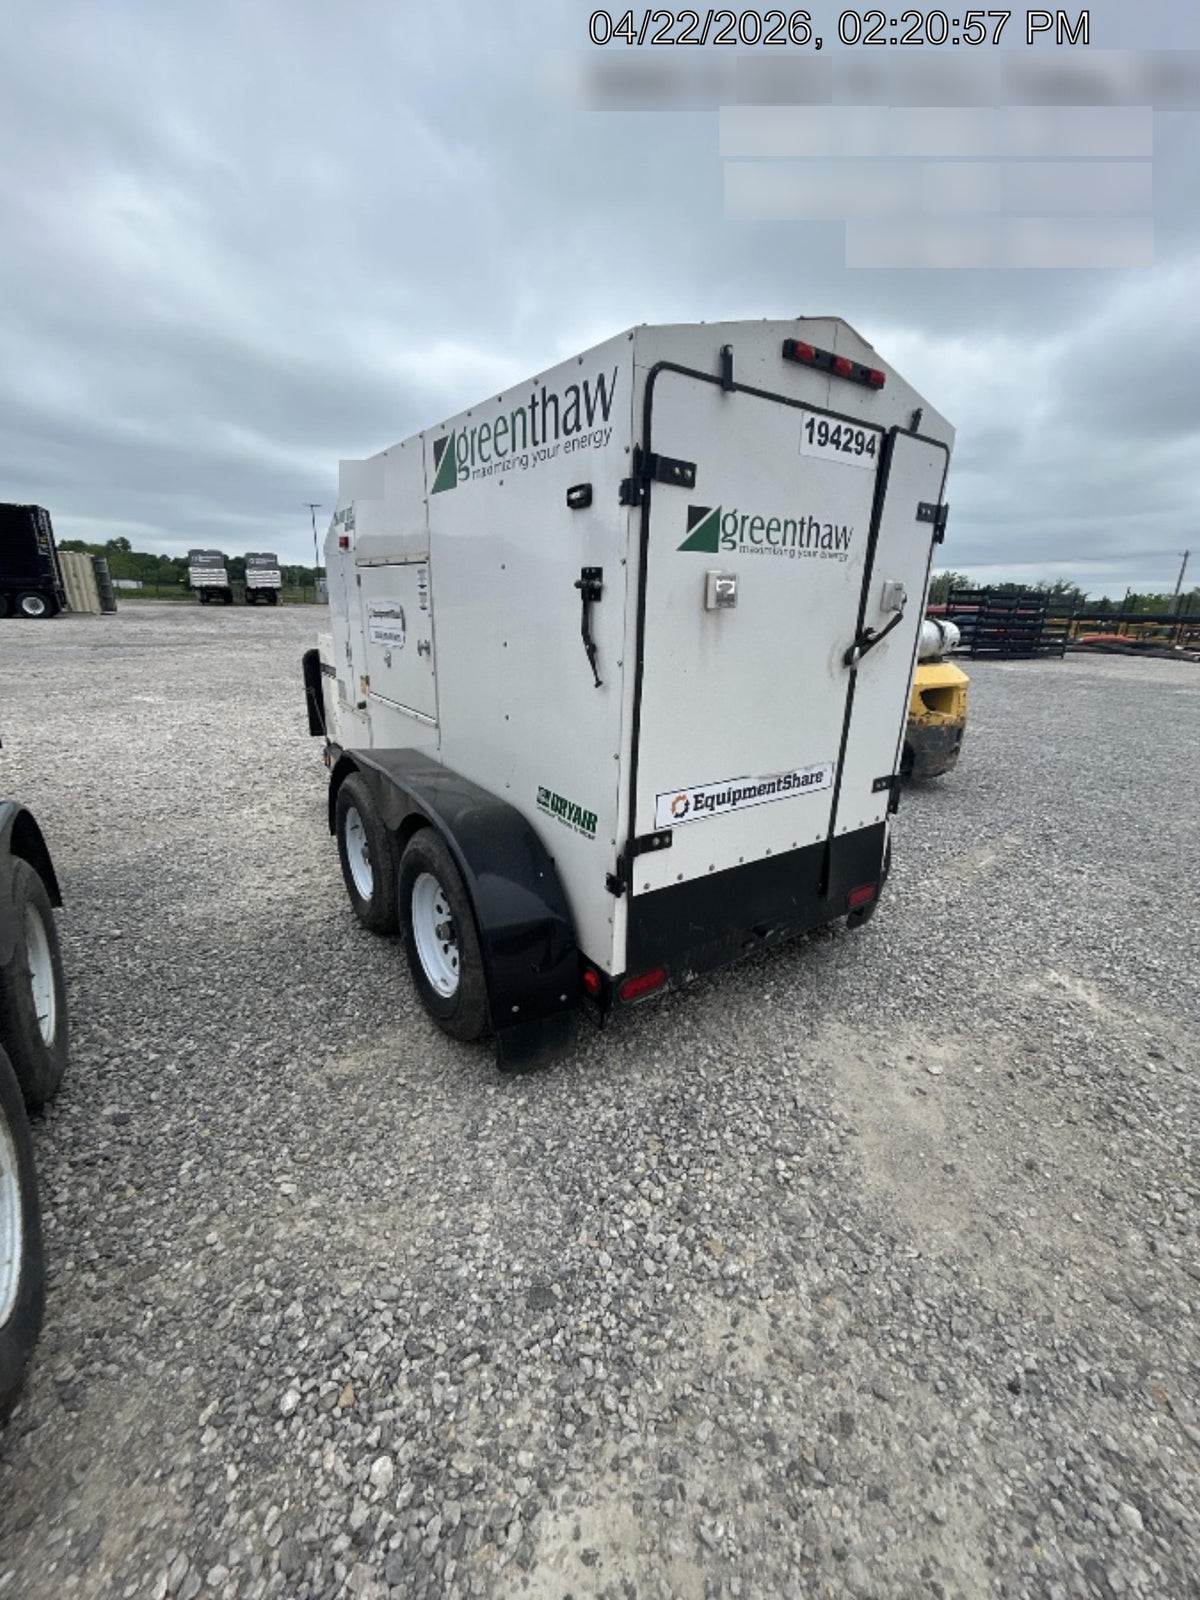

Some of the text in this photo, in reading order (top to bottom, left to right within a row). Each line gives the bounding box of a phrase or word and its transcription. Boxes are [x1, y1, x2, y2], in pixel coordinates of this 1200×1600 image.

[456, 366, 618, 481] greenthaw
[804, 417, 877, 459] 194294
[531, 444, 561, 468] your
[563, 426, 613, 454] energy
[721, 508, 854, 551] greenthaw
[692, 769, 825, 812] EquipmentShare
[550, 792, 598, 834] DRYAIR
